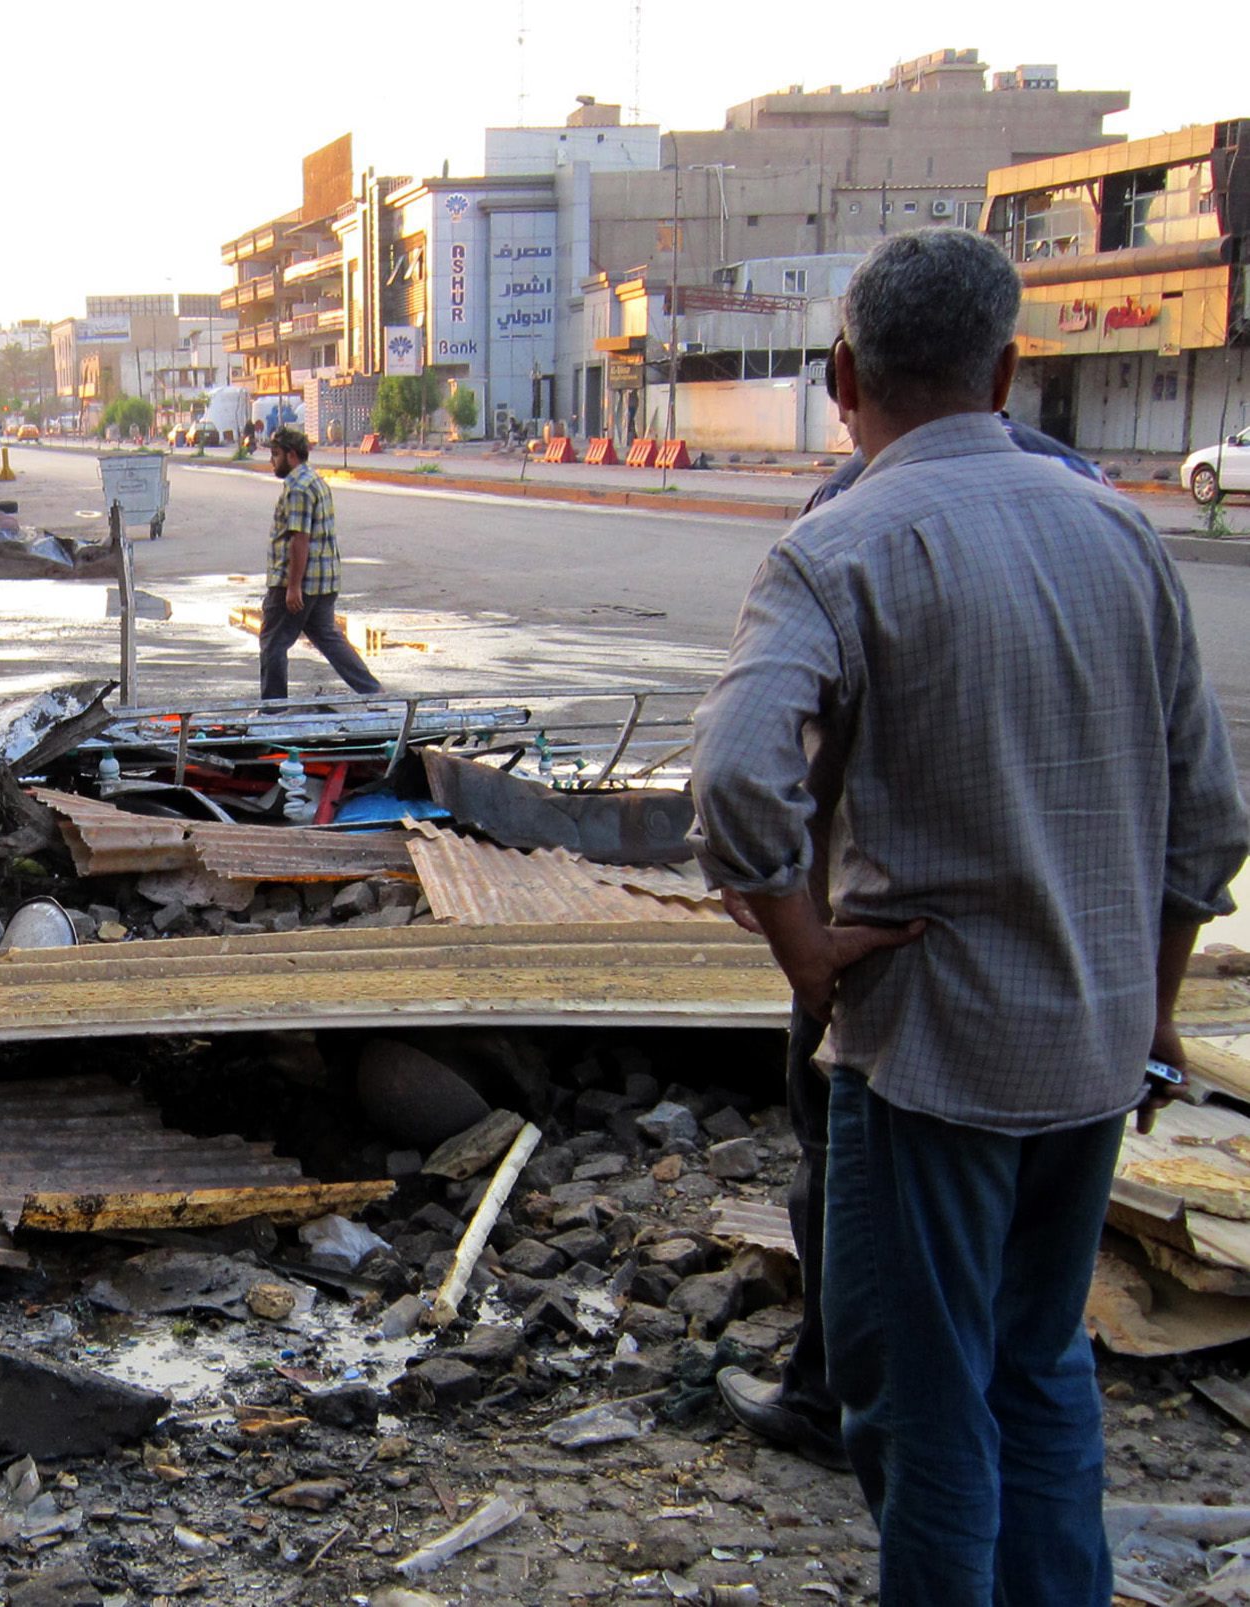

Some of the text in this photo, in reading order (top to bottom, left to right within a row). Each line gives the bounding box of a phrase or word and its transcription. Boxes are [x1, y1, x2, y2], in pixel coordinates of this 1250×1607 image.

[494, 244, 552, 261] مصرف
[452, 245, 465, 323] ASHUR
[499, 274, 551, 298] اشور
[497, 308, 551, 330] الدولي
[439, 339, 478, 355] Bank
